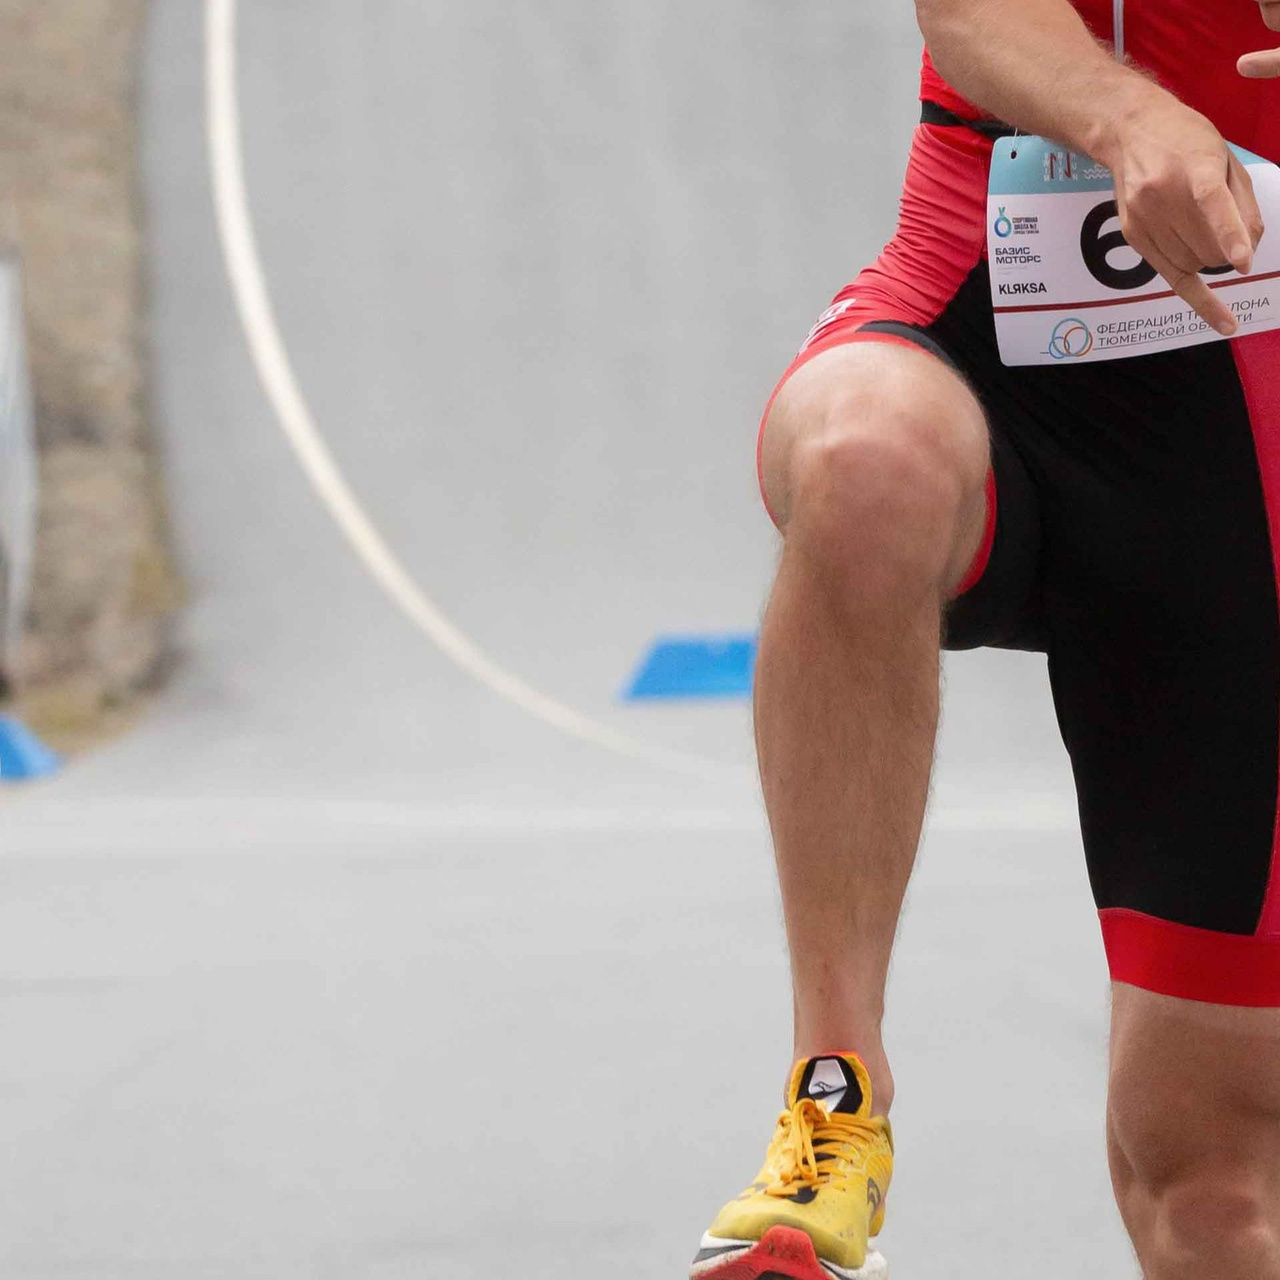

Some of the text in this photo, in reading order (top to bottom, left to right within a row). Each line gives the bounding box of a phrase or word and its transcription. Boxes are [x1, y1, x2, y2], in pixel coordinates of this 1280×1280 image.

[995, 247, 1031, 255] БАЗИС
[996, 255, 1042, 264] МОТОРС
[1096, 312, 1184, 335] ФЕДЕРАЦИЯ
[1098, 325, 1185, 347] ТЮМЕНСКОЙ
